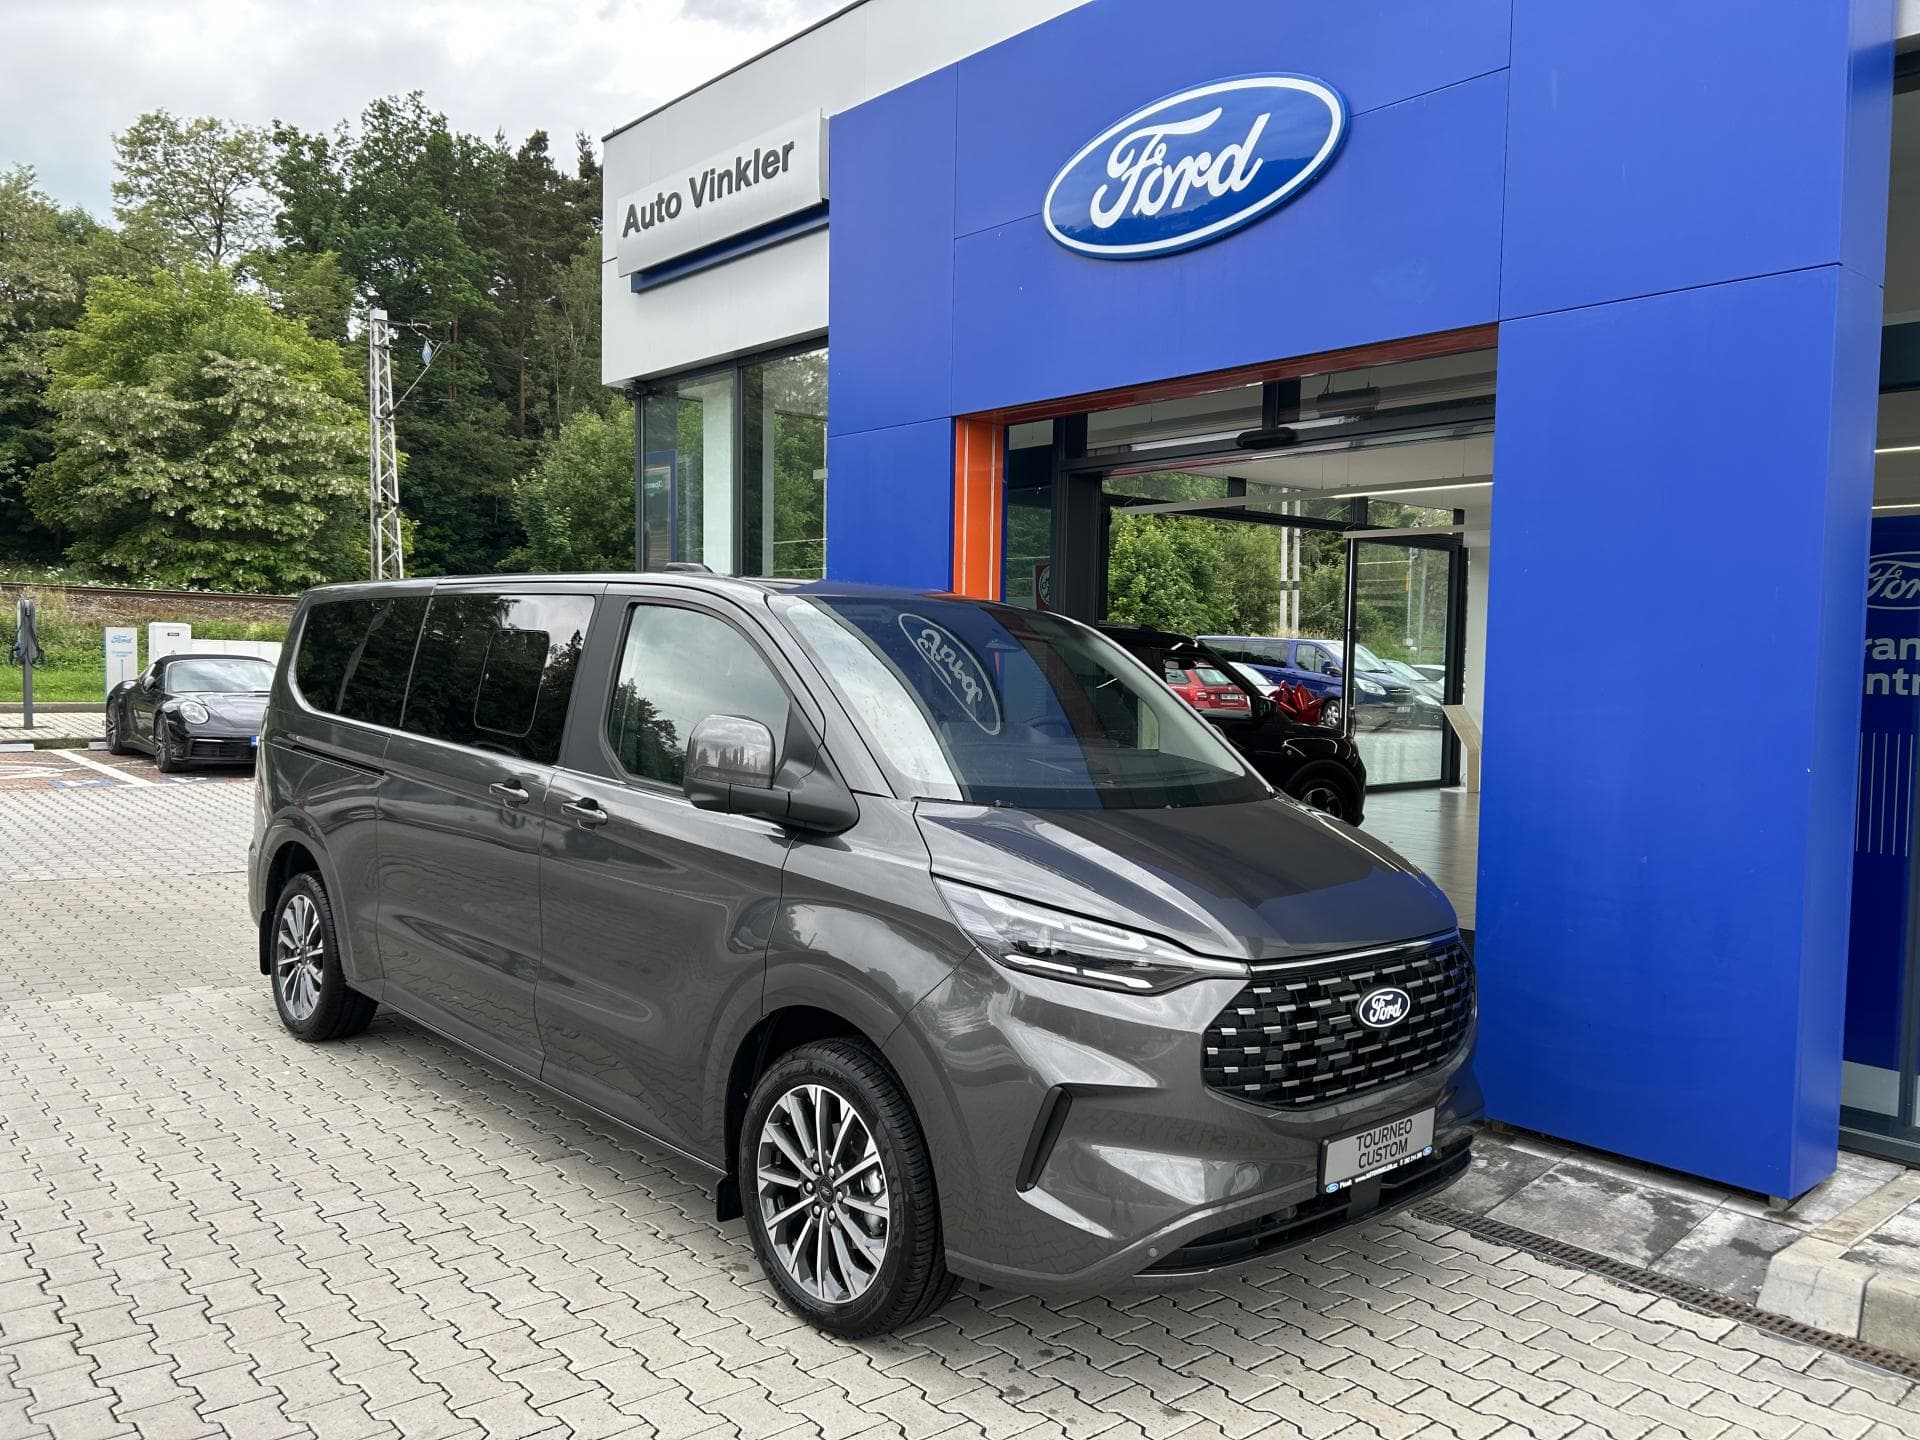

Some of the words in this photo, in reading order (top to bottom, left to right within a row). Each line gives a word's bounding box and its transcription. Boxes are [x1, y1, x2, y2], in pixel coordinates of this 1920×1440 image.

[1089, 106, 1271, 229] Ford
[622, 191, 682, 238] Auto
[688, 140, 795, 209] Vinkler
[1369, 992, 1403, 1023] Ford
[1356, 1117, 1413, 1152] TOURNEO
[1358, 1136, 1409, 1169] CUSTOM
